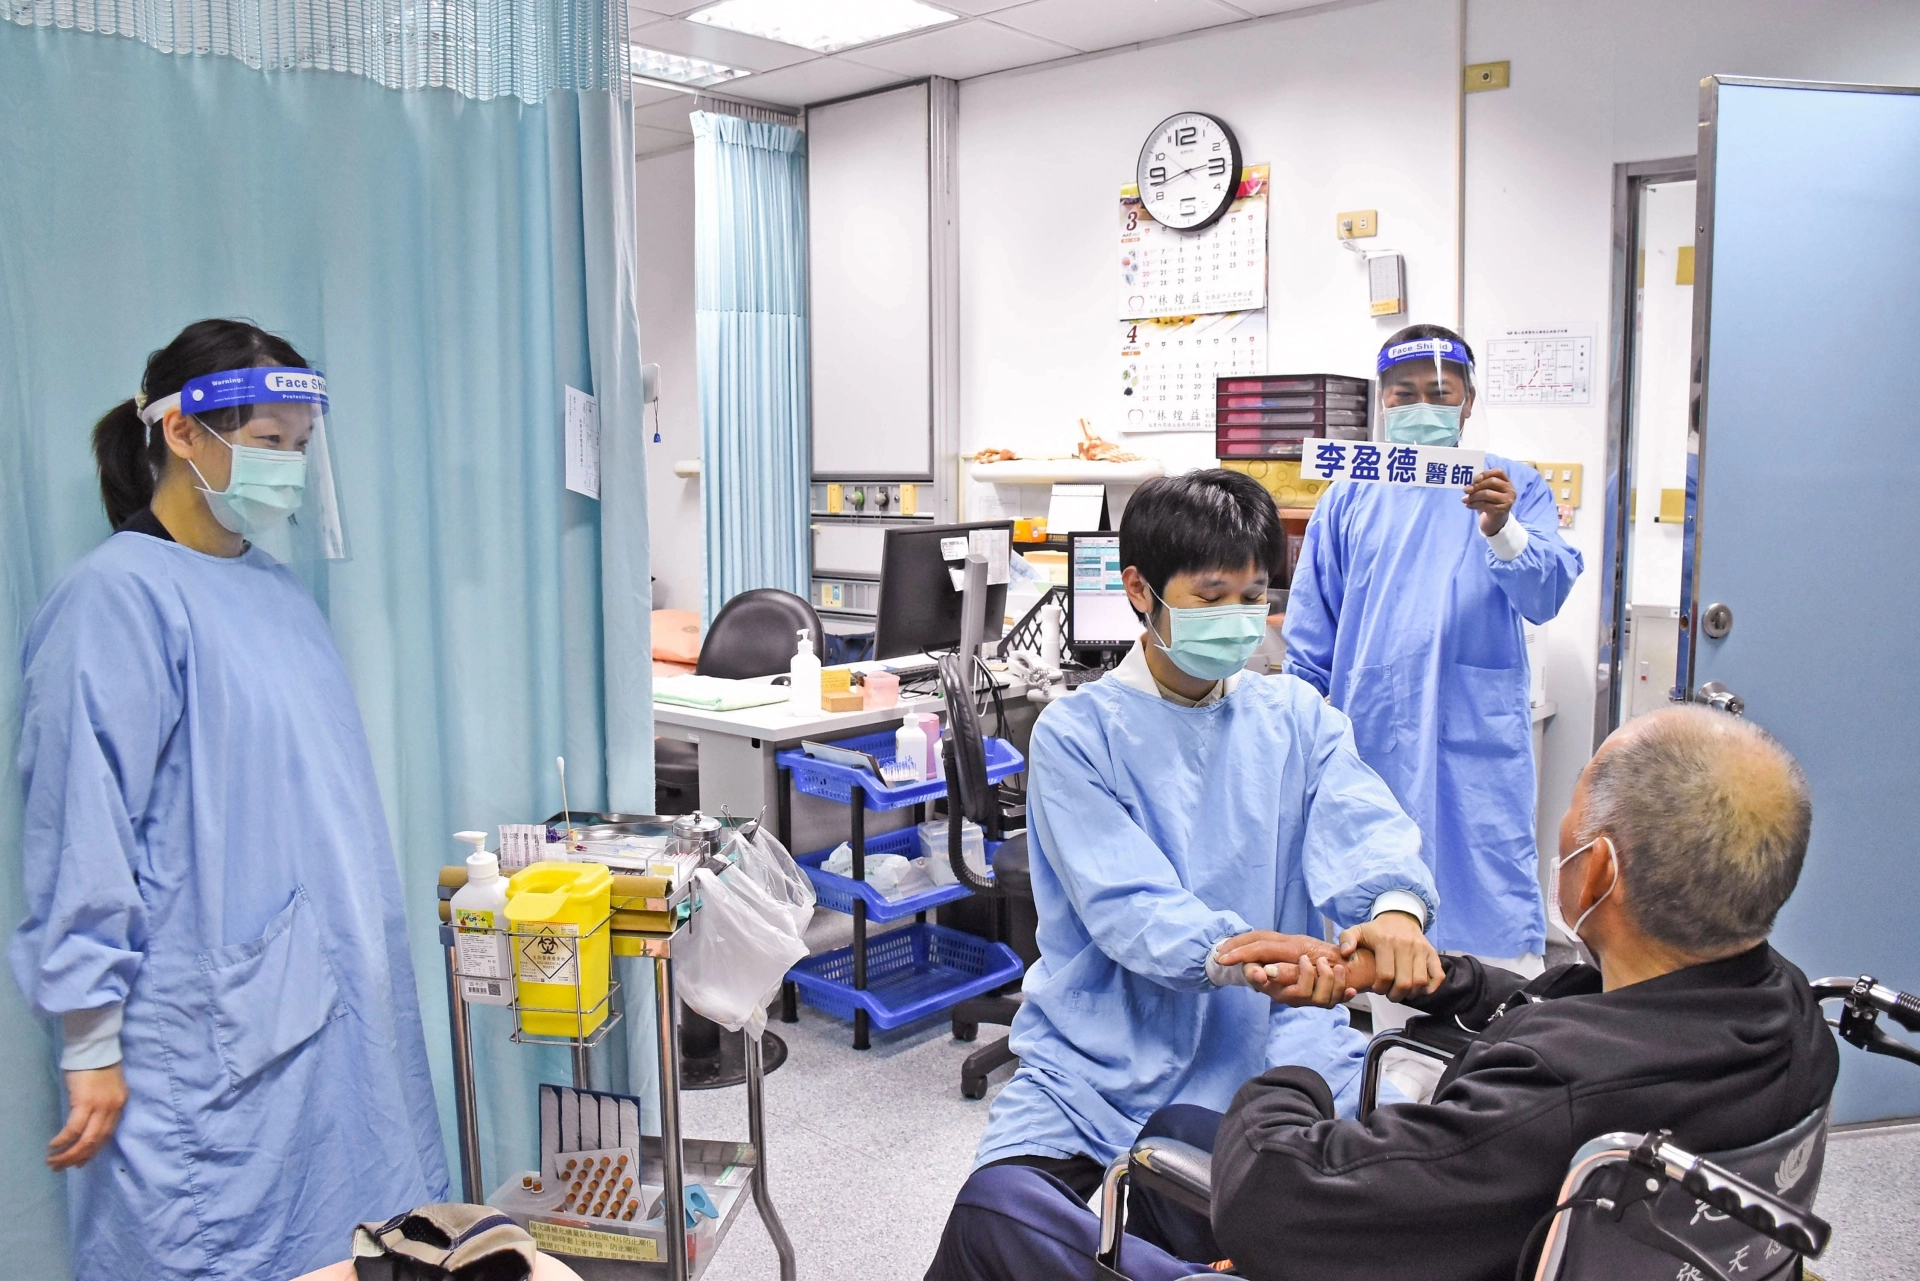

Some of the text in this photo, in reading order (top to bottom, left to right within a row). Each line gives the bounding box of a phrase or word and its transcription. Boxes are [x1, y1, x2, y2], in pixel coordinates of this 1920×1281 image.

[1175, 126, 1197, 147] 12
[1212, 142, 1221, 152] 2
[1155, 152, 1166, 162] 10
[1208, 157, 1226, 177] 3
[1149, 166, 1166, 186] 9
[1213, 182, 1221, 191] 4
[1155, 191, 1165, 201] 8
[1126, 211, 1138, 231] 3
[1126, 325, 1138, 343] 4
[1392, 342, 1448, 356] Face Shild
[211, 377, 244, 387] Warning:
[275, 376, 308, 388] Face
[1315, 442, 1474, 487] 李盈德 醫師
